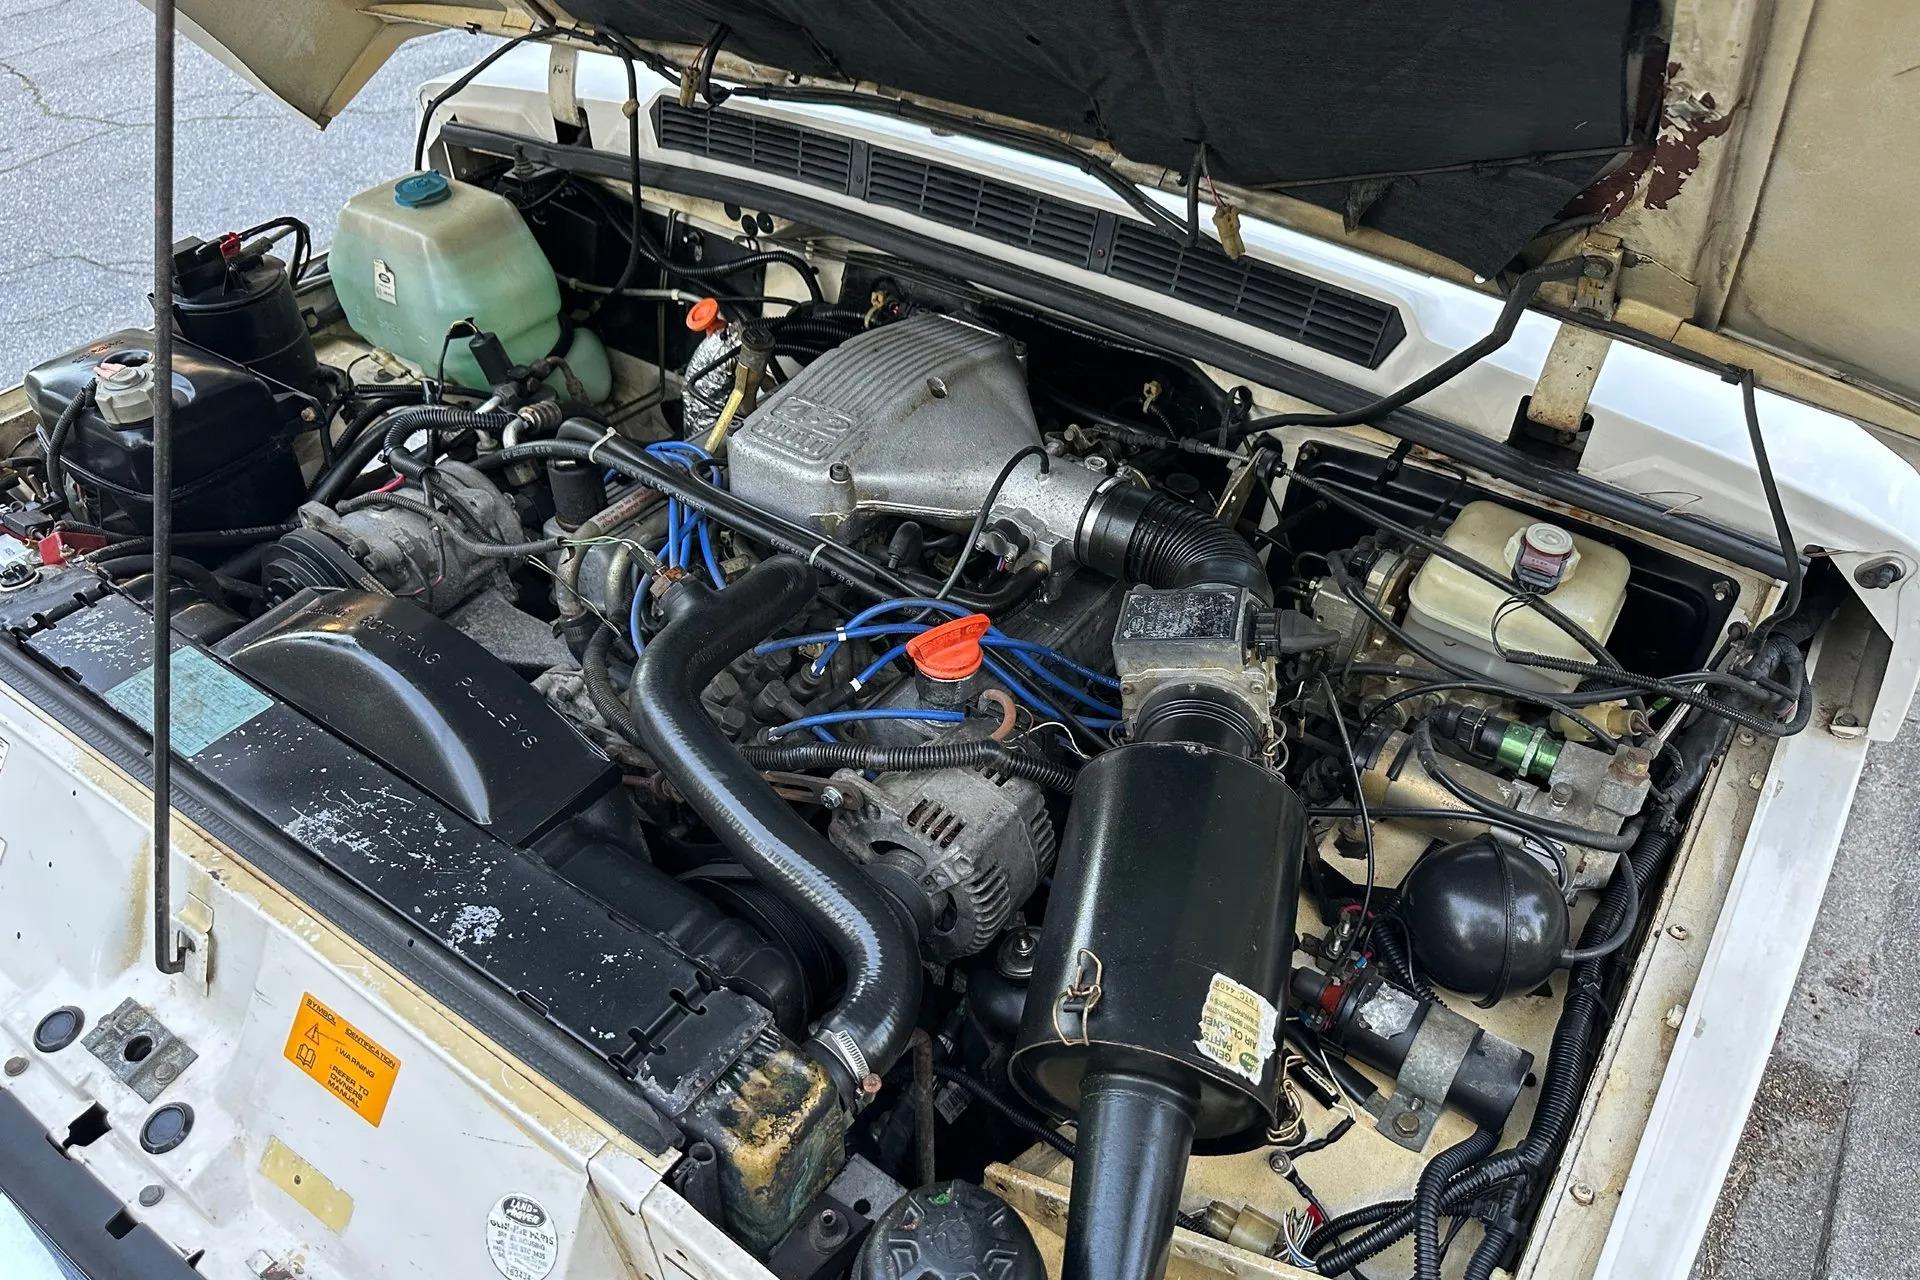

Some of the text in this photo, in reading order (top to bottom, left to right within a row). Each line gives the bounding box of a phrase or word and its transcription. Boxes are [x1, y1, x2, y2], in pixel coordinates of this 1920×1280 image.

[1215, 980, 1256, 1006] NTC 4408
[305, 997, 396, 1070] SYMBOL IDENTIFICATION
[1203, 1031, 1234, 1052] PARTS
[1244, 1034, 1258, 1050] AIR
[327, 1079, 361, 1109] MANUAL
[329, 1072, 364, 1102] OWNERS
[358, 1084, 370, 1097] TO
